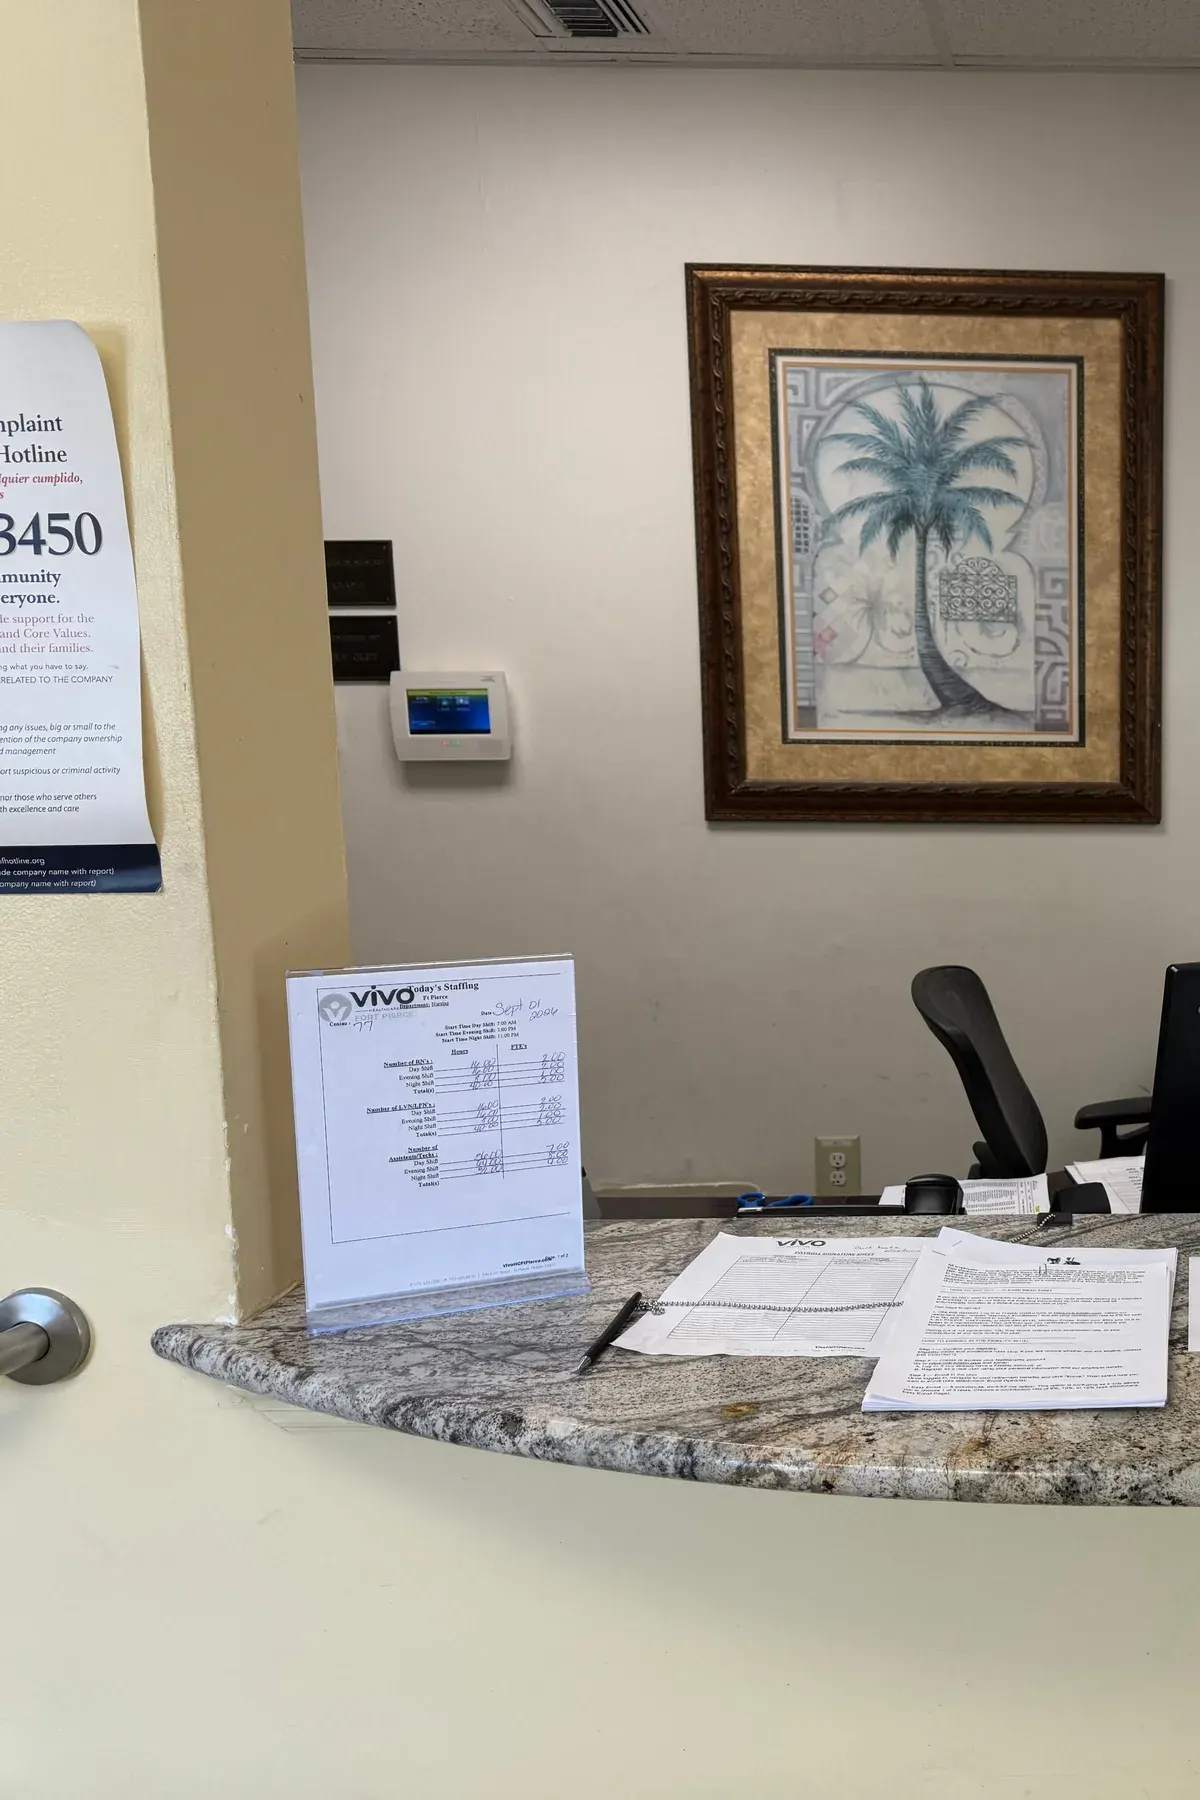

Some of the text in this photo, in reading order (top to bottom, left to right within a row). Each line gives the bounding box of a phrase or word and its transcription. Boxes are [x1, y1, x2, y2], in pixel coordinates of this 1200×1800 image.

[33, 472, 83, 485] cumplido,
[0, 569, 61, 587] munity
[0, 594, 60, 608] eryone.
[12, 614, 55, 626] support
[58, 613, 73, 623] for
[77, 614, 94, 623] the
[0, 628, 91, 638] and Core Values.
[0, 642, 93, 653] nd their families.
[10, 662, 27, 670] what
[30, 664, 43, 672] you
[45, 662, 63, 670] have
[71, 675, 113, 683] COMPANY
[9, 725, 23, 733] any
[50, 722, 61, 732] big
[73, 722, 93, 731] small
[104, 722, 116, 730] the
[25, 734, 33, 743] of
[34, 734, 46, 742] the
[48, 736, 82, 744] company
[84, 734, 123, 743] ownership
[5, 747, 56, 756] management
[13, 767, 51, 776] suspicious
[62, 766, 92, 774] criminal
[94, 766, 121, 776] activity
[14, 793, 34, 801] those
[36, 792, 52, 801] who
[53, 793, 73, 801] serve
[75, 791, 97, 801] others
[8, 805, 46, 813] excellence
[47, 804, 62, 813] and
[13, 869, 47, 877] company
[70, 867, 87, 875] with
[88, 867, 115, 876] report)
[53, 879, 69, 887] with
[70, 879, 97, 889] report)
[444, 982, 479, 992] Staffing
[493, 998, 523, 1017] Sept
